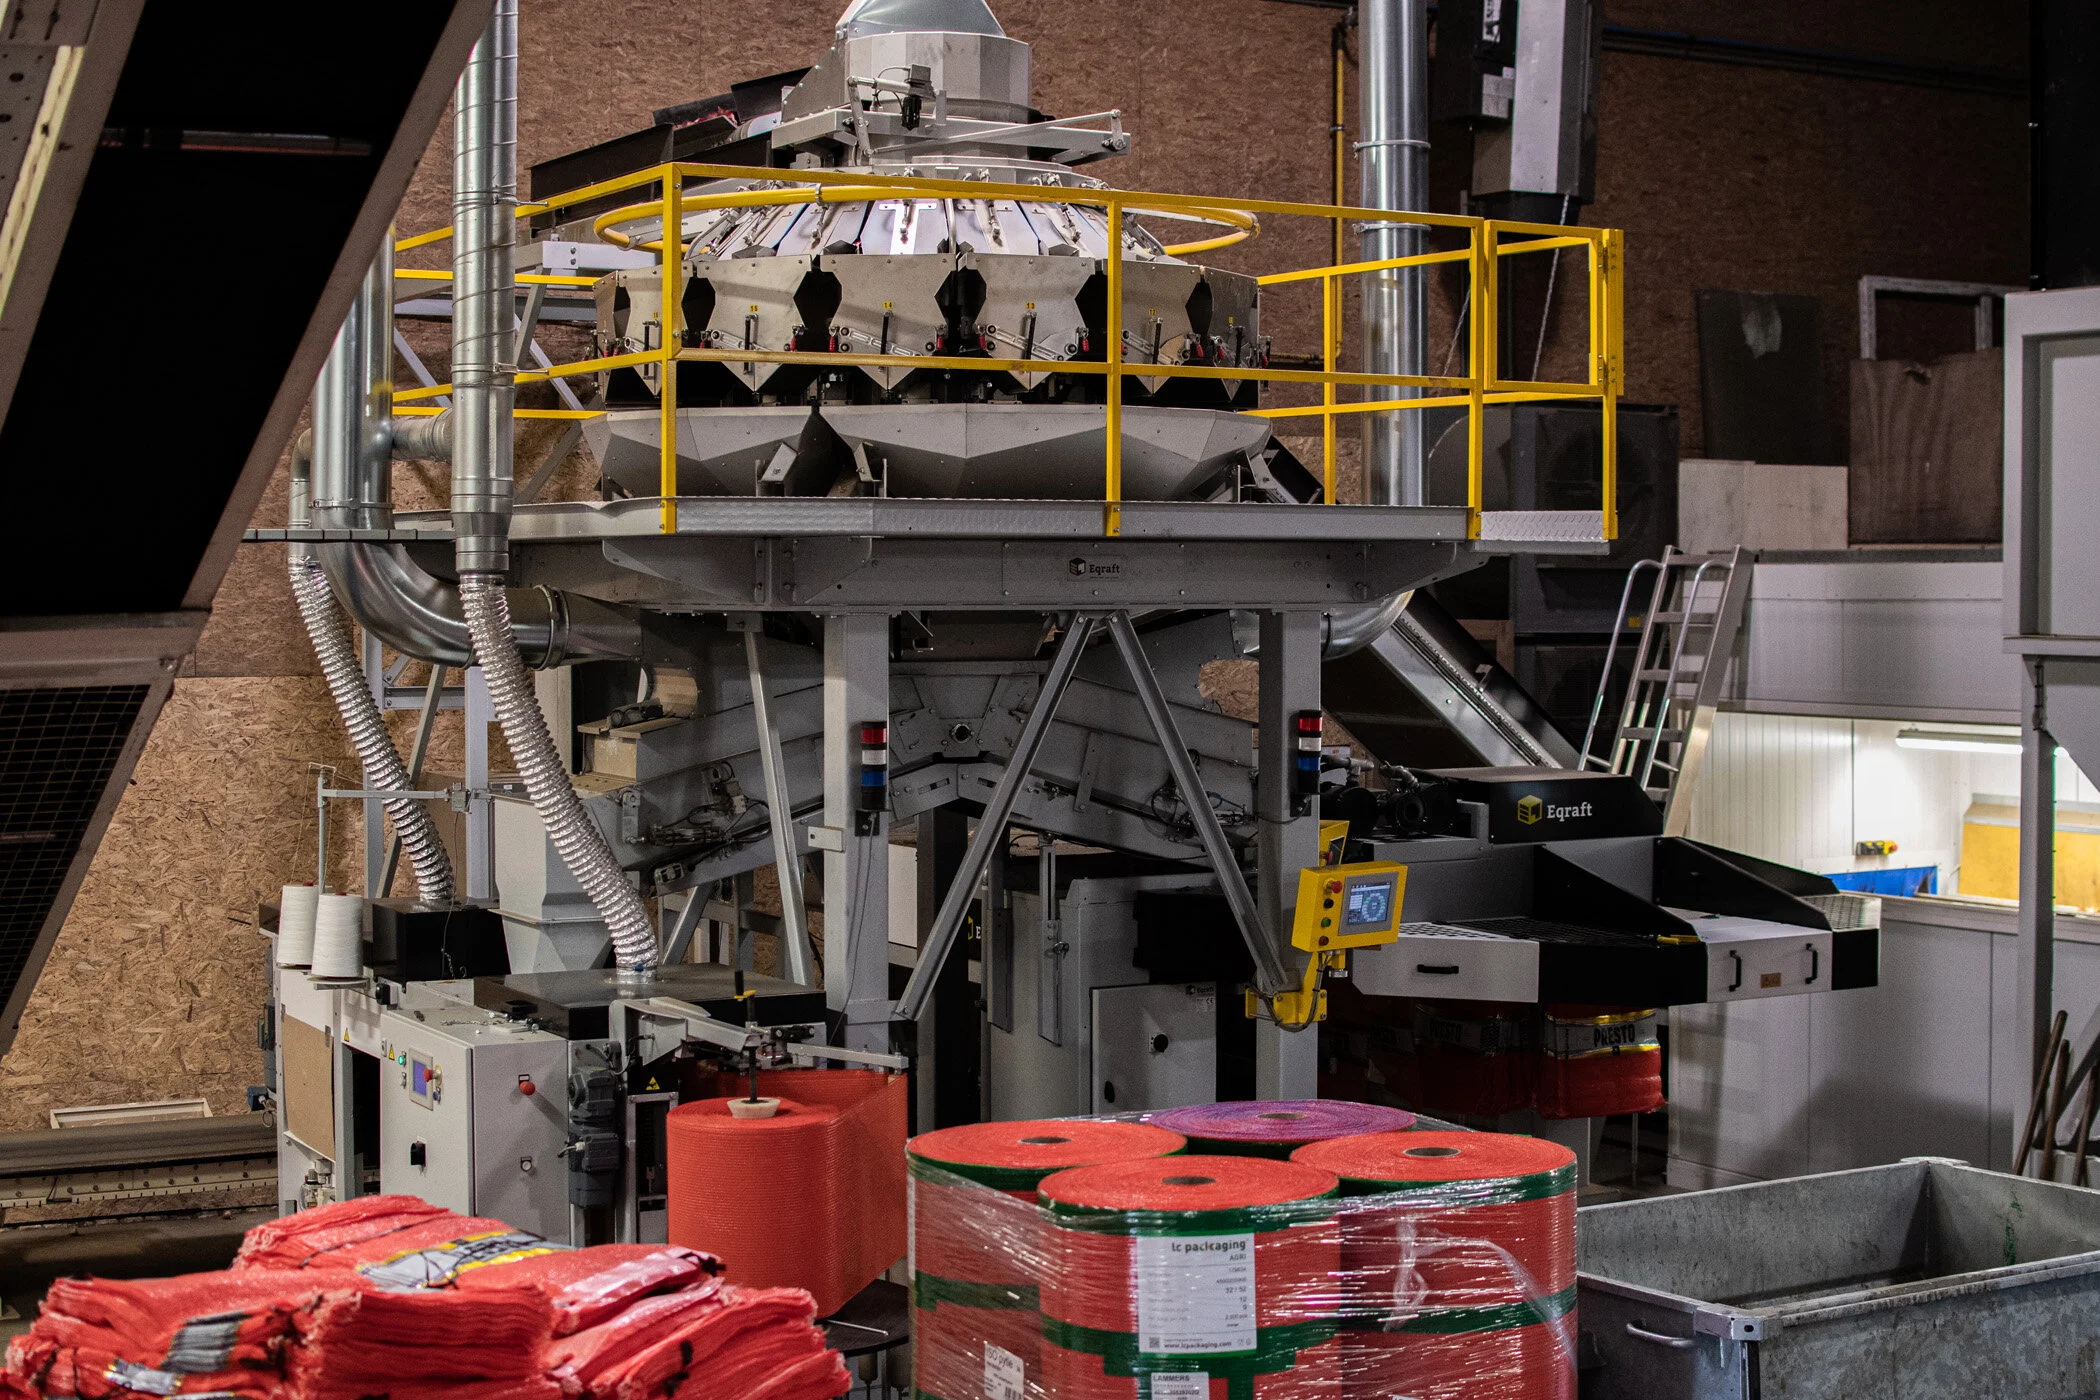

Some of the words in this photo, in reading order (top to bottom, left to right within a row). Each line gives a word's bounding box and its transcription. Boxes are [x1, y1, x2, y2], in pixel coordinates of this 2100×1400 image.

[1089, 563, 1120, 575] Eqraft
[1547, 802, 1592, 822] Eqraft
[1594, 1024, 1636, 1047] PRESTO
[1185, 1240, 1246, 1253] packaging
